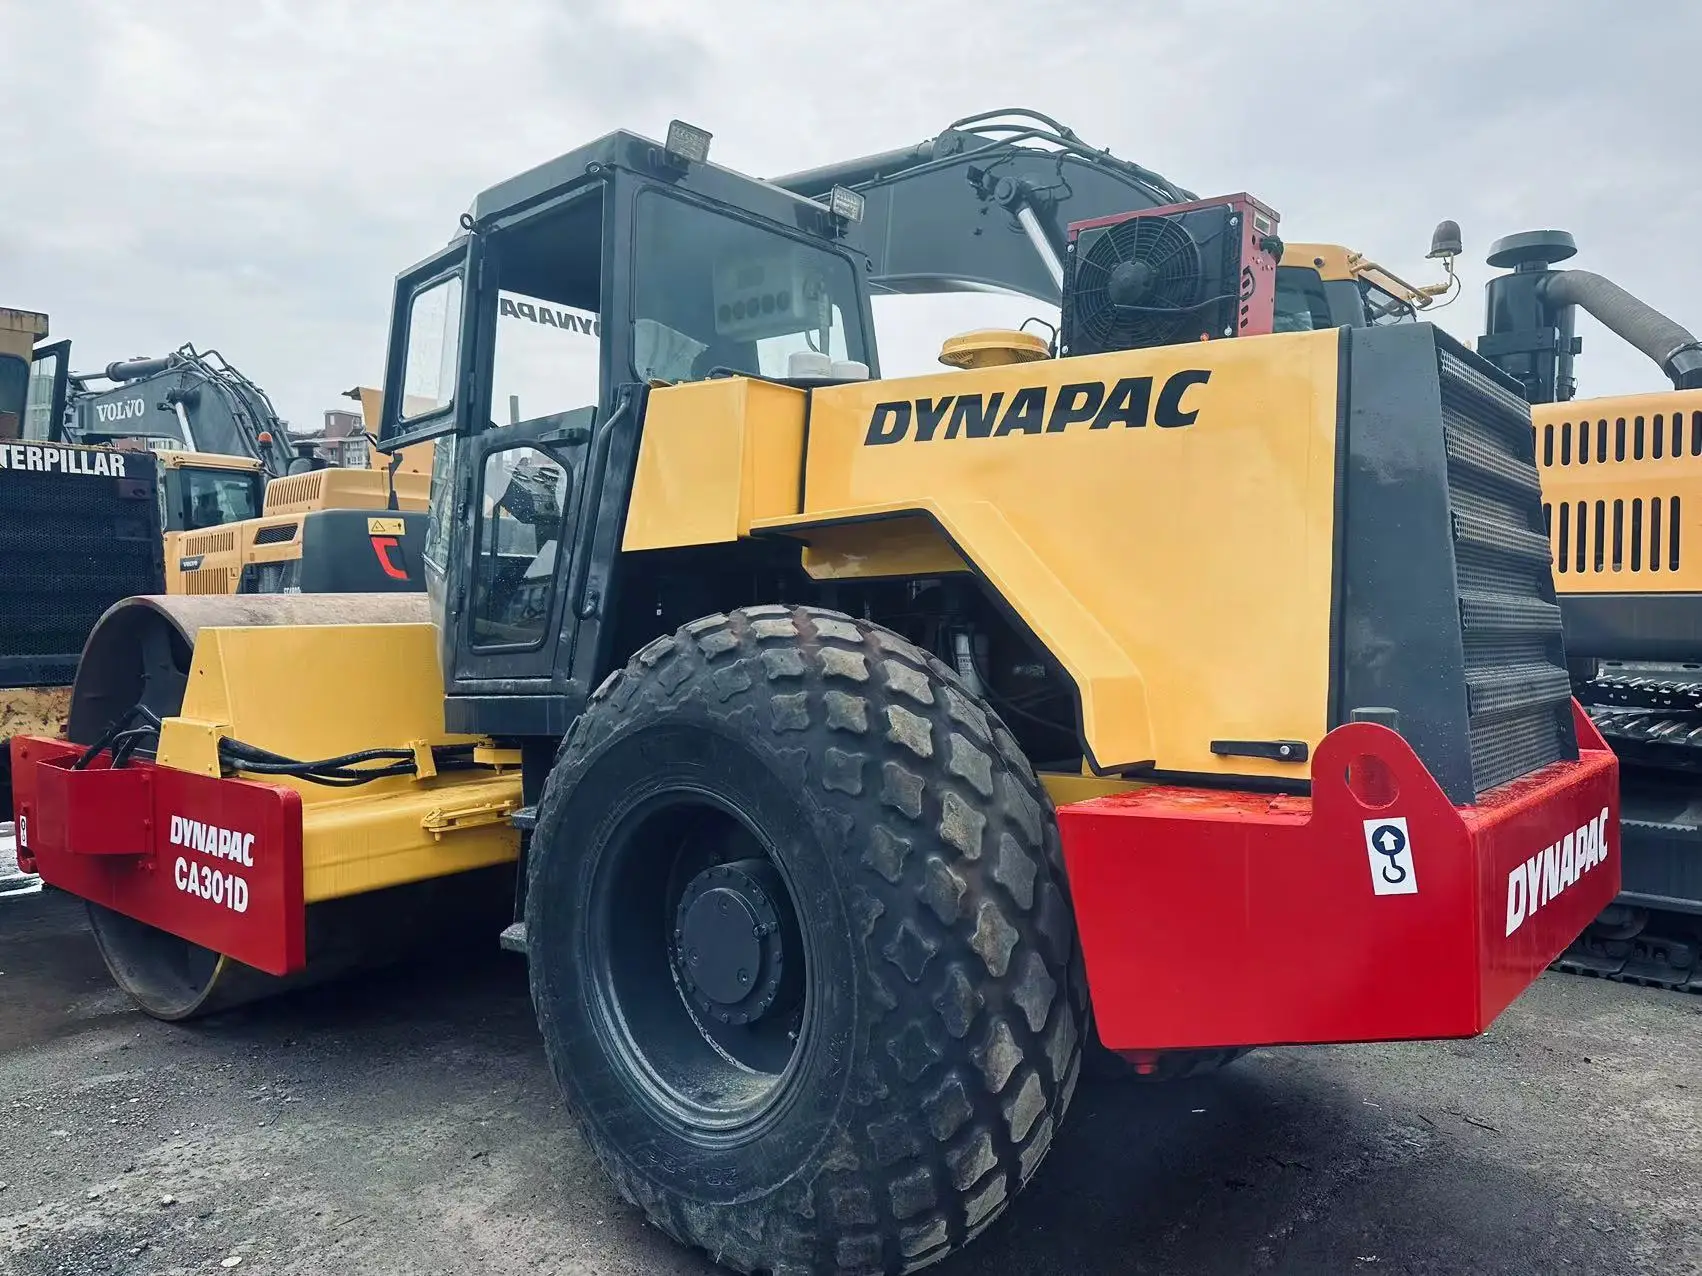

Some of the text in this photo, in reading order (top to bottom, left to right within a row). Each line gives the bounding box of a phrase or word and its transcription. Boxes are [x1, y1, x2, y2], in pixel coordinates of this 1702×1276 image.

[96, 398, 145, 422] VOLVO
[864, 370, 1211, 446] DYNAPAC
[170, 815, 255, 867] DYNAPAC
[174, 856, 249, 913] CA301D
[1505, 807, 1609, 938] DYNAPAC
